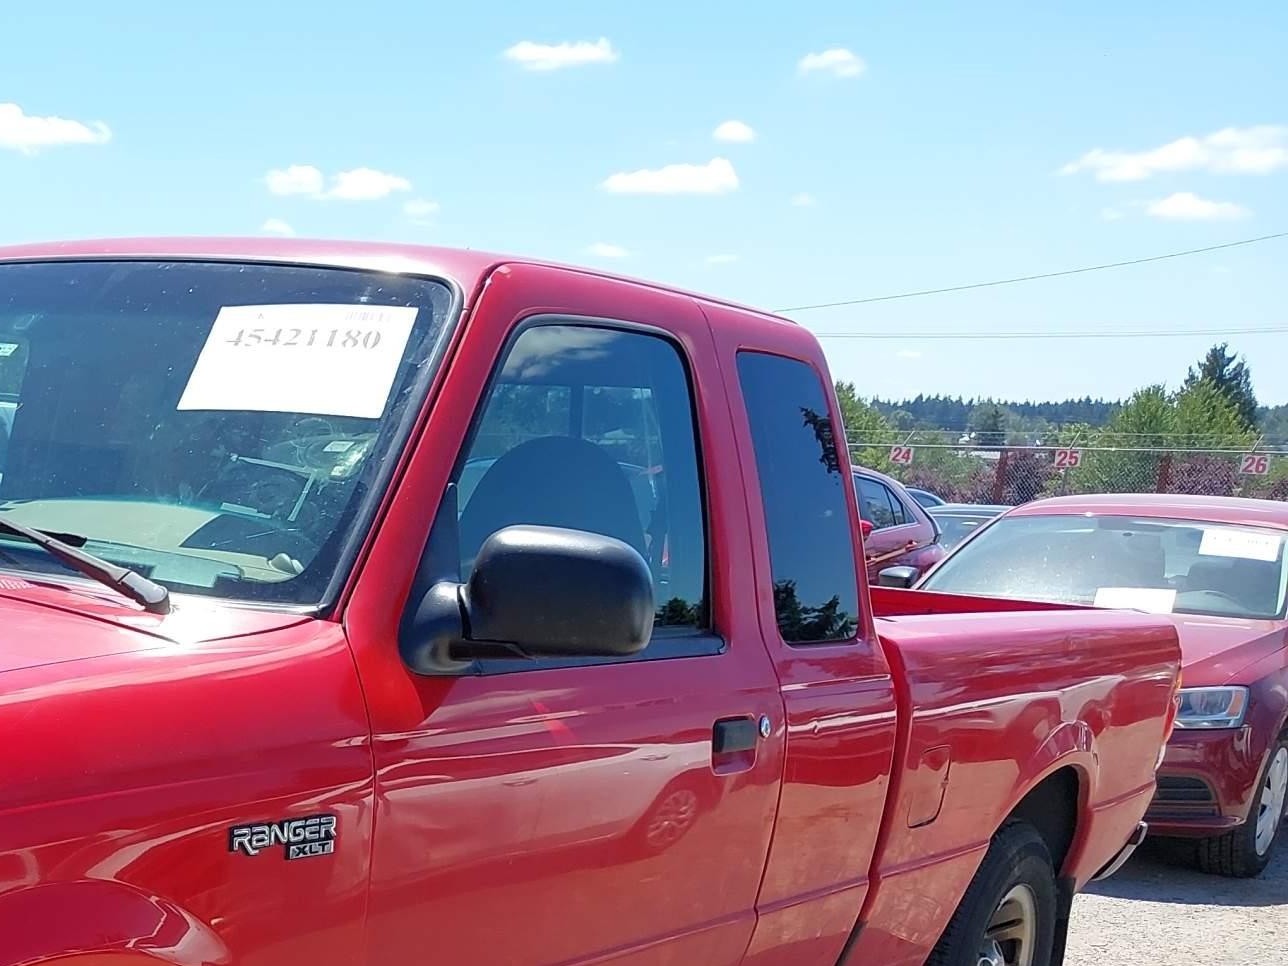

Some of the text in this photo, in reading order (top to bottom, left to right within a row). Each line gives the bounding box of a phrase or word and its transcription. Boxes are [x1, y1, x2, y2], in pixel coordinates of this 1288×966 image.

[224, 327, 382, 349] 45421180
[892, 446, 912, 462] 24
[1056, 450, 1079, 466] 25
[1242, 456, 1268, 474] 26
[232, 816, 337, 856] RANGER
[293, 841, 332, 858] XLT
